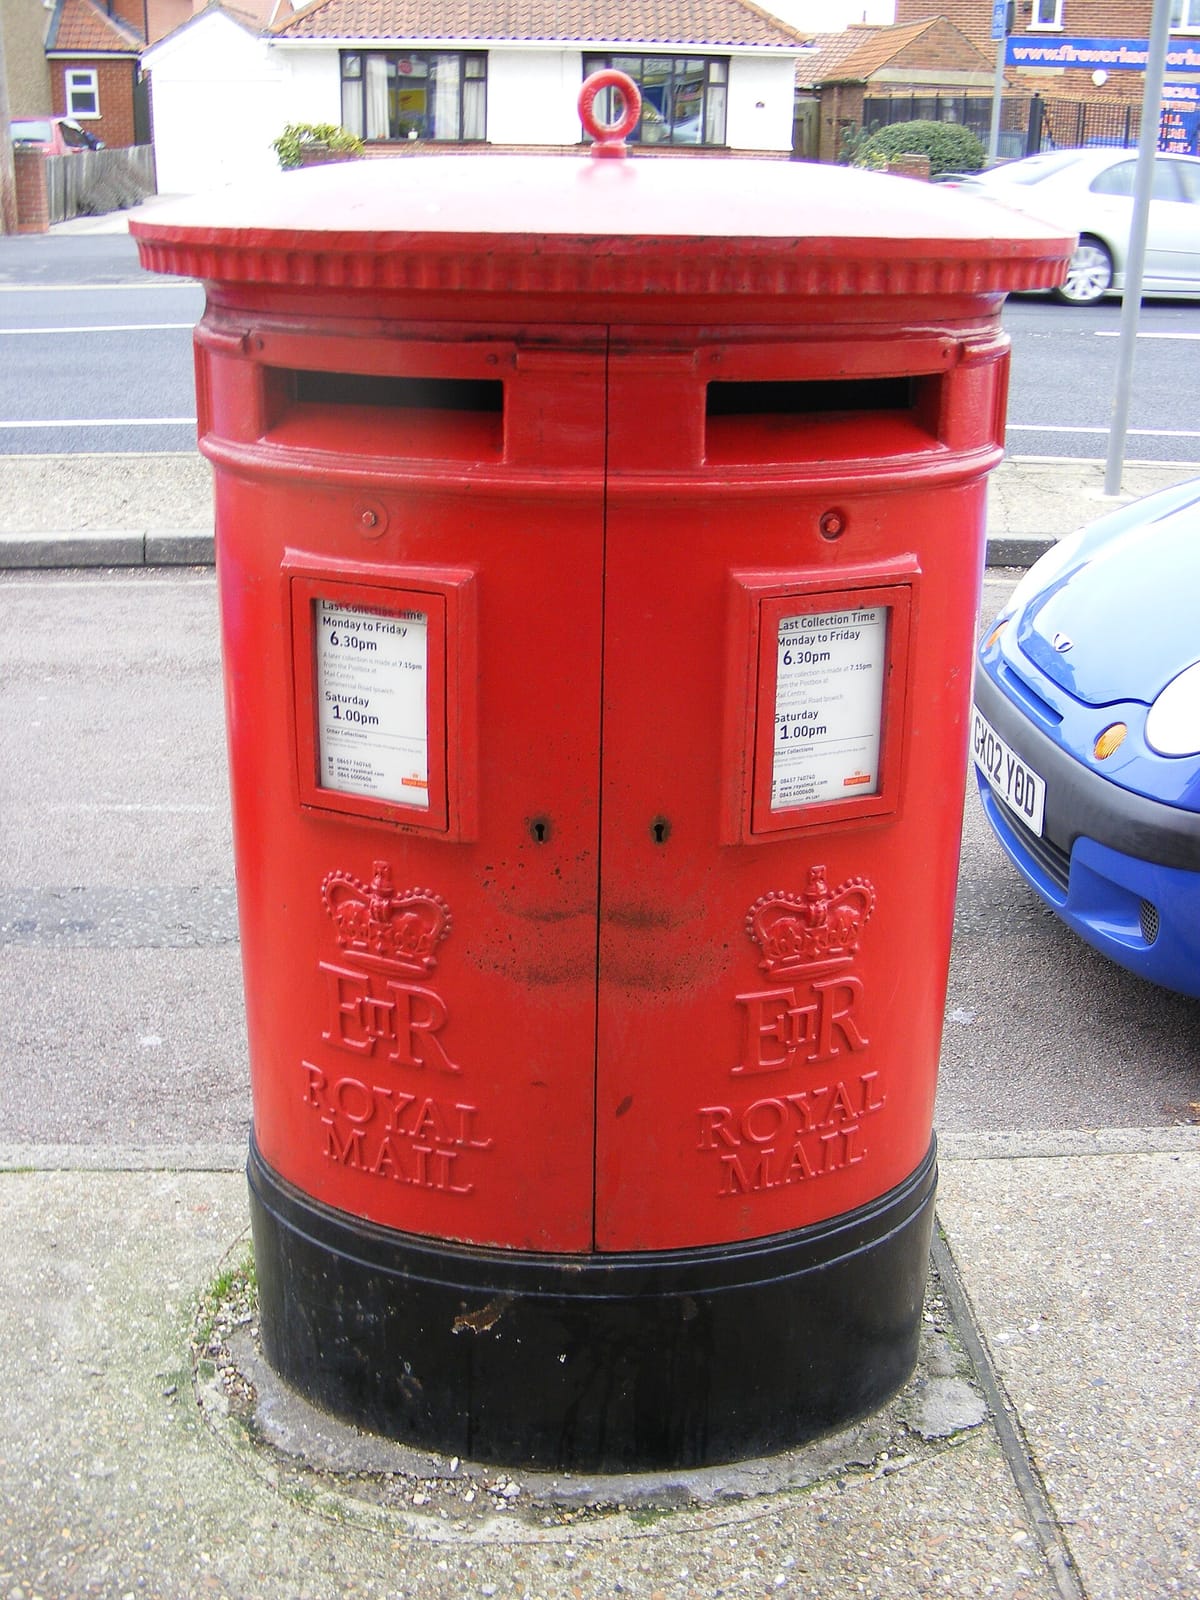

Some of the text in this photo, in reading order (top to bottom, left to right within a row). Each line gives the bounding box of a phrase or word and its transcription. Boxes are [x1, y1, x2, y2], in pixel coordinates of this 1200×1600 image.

[322, 616, 408, 637] Monday to Friday
[801, 615, 849, 628] Collection
[851, 612, 876, 623] Time
[330, 631, 377, 651] 6.30pm
[818, 634, 828, 643] to
[830, 630, 861, 642] Friday
[399, 661, 423, 672] 7.15pm
[783, 650, 831, 666] 6.30pm
[849, 663, 872, 673] 7.15pm
[325, 691, 370, 708] Saturday
[332, 704, 379, 726] 1.00pm
[775, 710, 819, 723] Saturday
[780, 724, 827, 740] 1.00pm
[787, 746, 814, 755] Collections
[974, 715, 1036, 818] GX02 YOD
[301, 1059, 492, 1146] ROYAL
[698, 1071, 886, 1148] ROYAL
[321, 1116, 474, 1192] MAIL
[717, 1125, 868, 1196] MAIL
